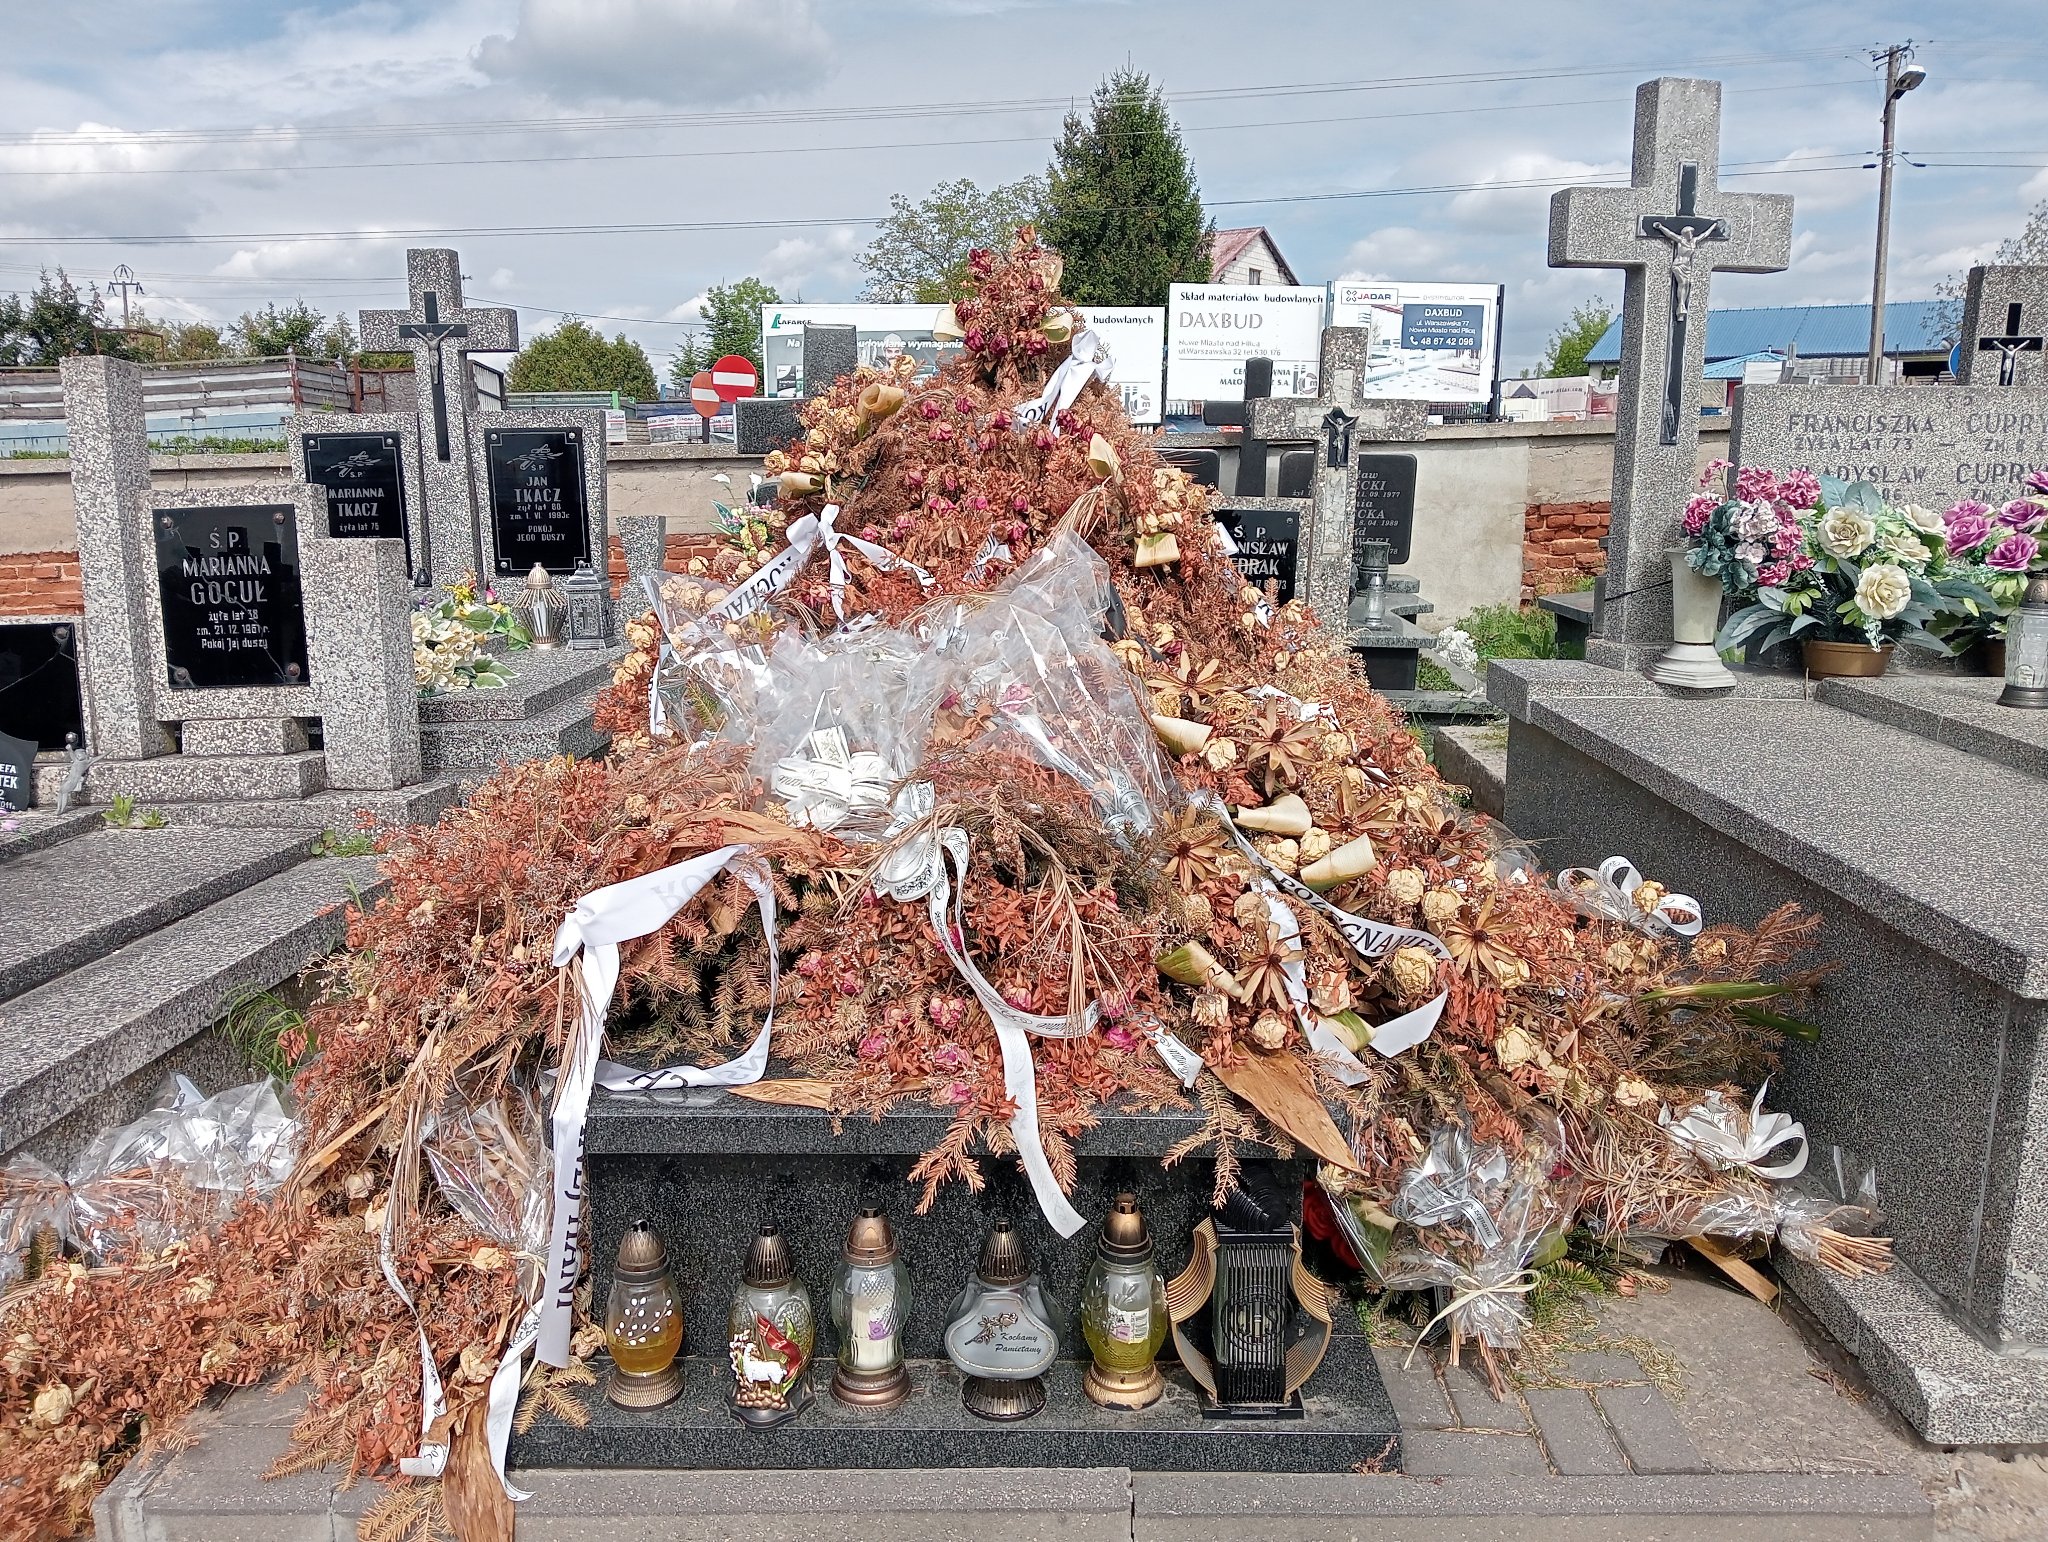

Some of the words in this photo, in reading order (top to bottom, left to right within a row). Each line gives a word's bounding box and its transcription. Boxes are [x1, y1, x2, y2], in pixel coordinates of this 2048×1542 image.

[1180, 292, 1205, 301] Skład
[1264, 294, 1323, 305] budowlanych
[1424, 308, 1463, 317] DAXBUD
[1093, 315, 1154, 326] budowlanych
[1179, 311, 1263, 329] DAXBUD
[857, 339, 906, 348] udowlane
[907, 338, 964, 350] wymagania
[1459, 338, 1474, 346] 096
[1788, 414, 1934, 433] FRANCISZKA
[1787, 463, 1926, 484] ADYSŁAW
[526, 477, 548, 486] JAN
[328, 488, 385, 498] MARIANNA
[514, 488, 562, 502] TKACZ
[337, 503, 379, 517] TKACZ
[358, 522, 368, 531] lat
[541, 533, 566, 541] DUSZY
[182, 555, 271, 577] MARIANNA
[191, 580, 268, 605] GOCUŁ
[208, 611, 229, 623] żyła
[232, 610, 245, 620] lat
[242, 637, 268, 650] duszy
[1000, 1332, 1038, 1342] Kochamy
